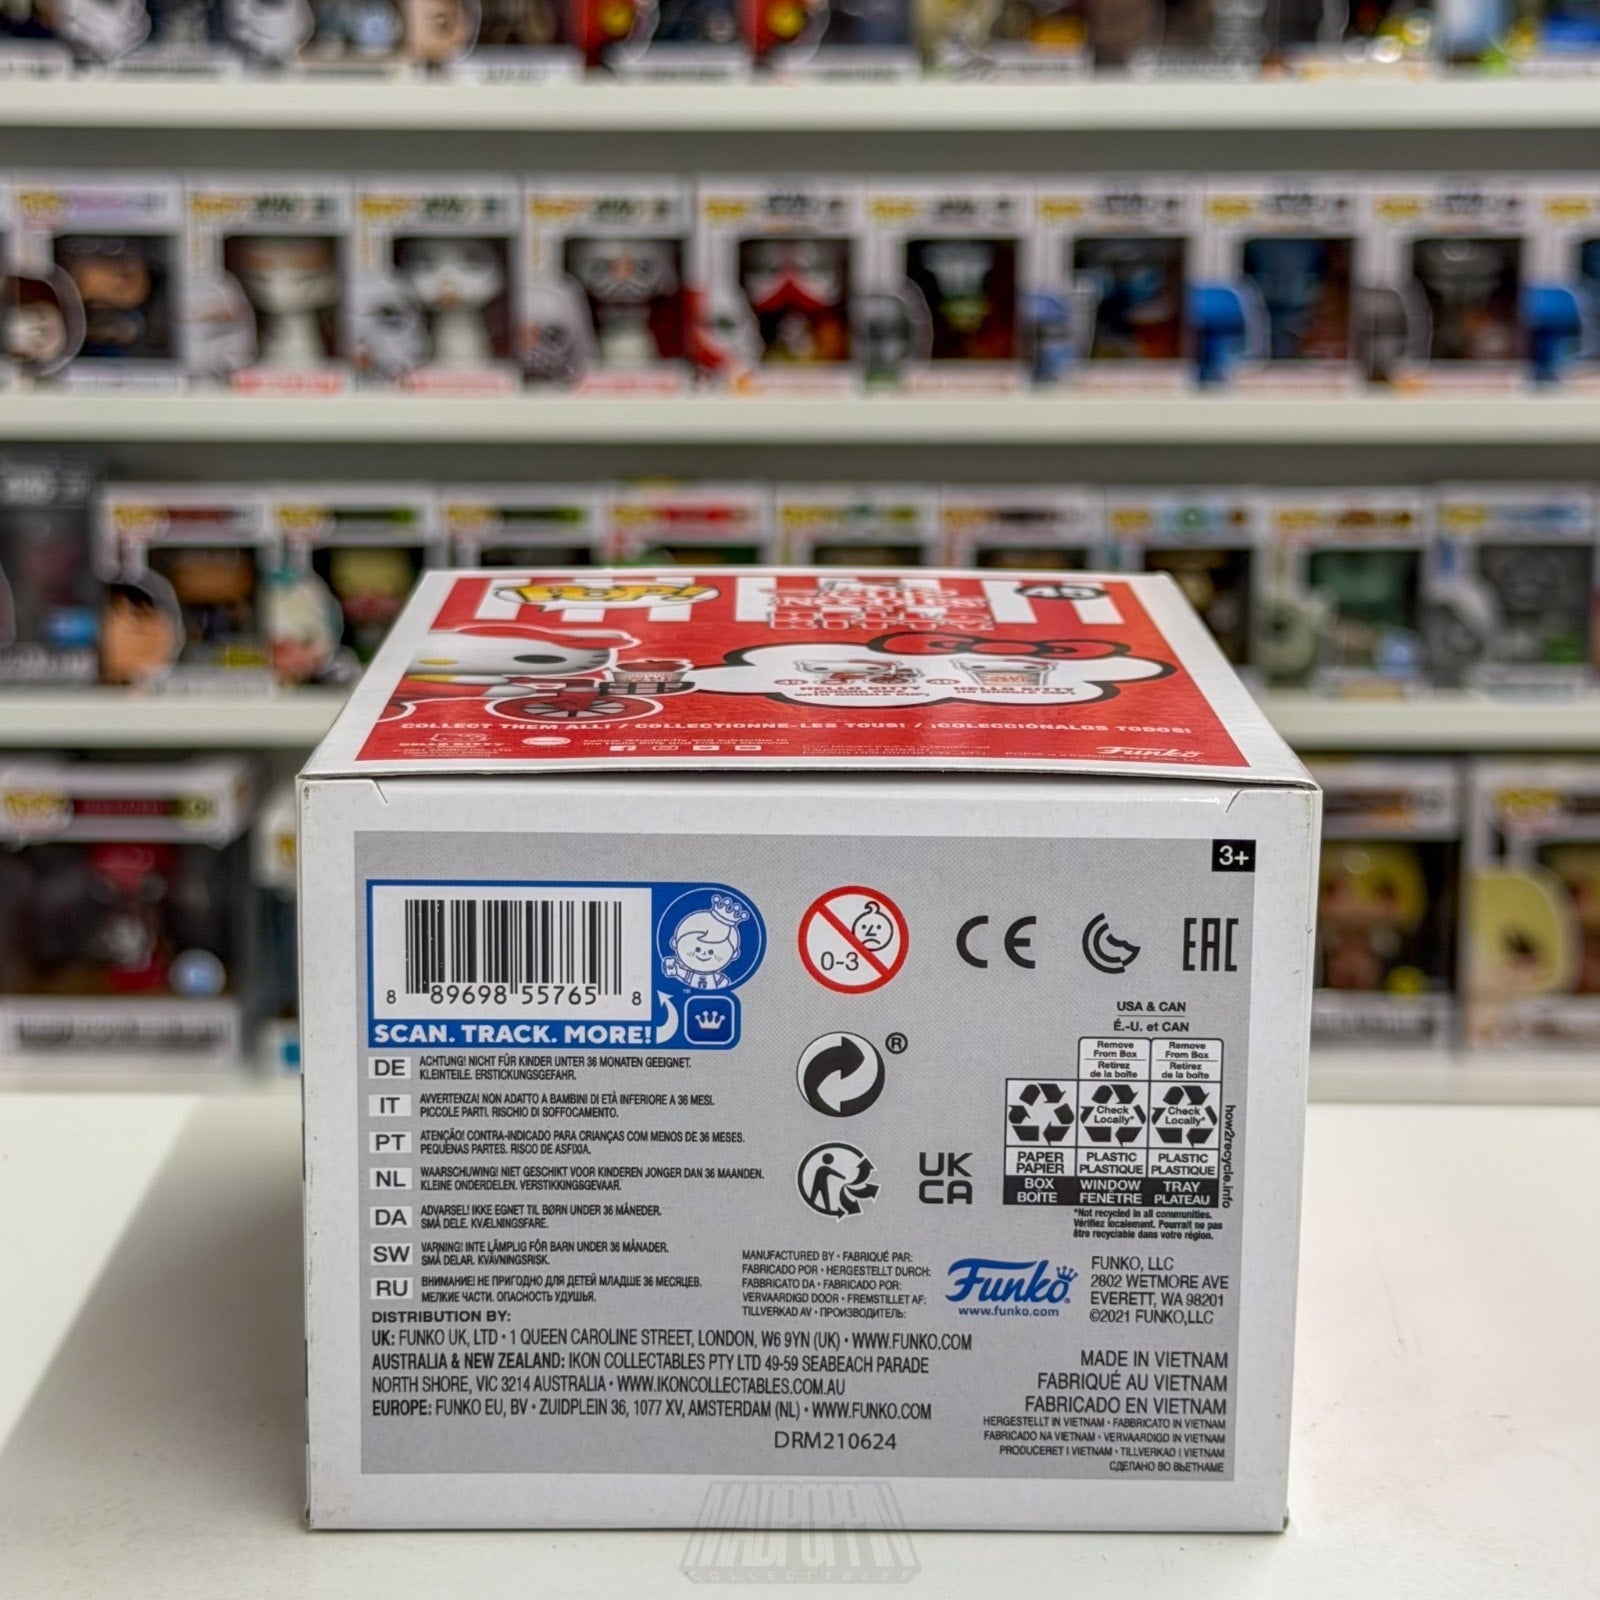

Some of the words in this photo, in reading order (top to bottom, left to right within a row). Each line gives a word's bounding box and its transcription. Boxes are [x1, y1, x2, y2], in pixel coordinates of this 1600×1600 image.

[1115, 725, 1192, 734] TODOS!
[1096, 746, 1204, 758] Funko
[1219, 846, 1250, 866] 3+
[956, 915, 1037, 969] CE
[821, 951, 860, 972] 0-3
[386, 989, 397, 1005] 8
[430, 985, 508, 1005] 89698
[521, 985, 597, 1005] 55765
[631, 991, 643, 1006] 8
[1116, 1001, 1143, 1011] USA
[1146, 1001, 1155, 1011] &
[1158, 1001, 1186, 1012] CAN
[1113, 1018, 1142, 1031] É.-U.
[1146, 1021, 1158, 1031] et
[1161, 1021, 1189, 1032] CAN
[374, 1024, 455, 1042] SCAN.
[461, 1024, 557, 1043] TRACK.
[564, 1025, 651, 1043] MORE!
[374, 1059, 406, 1077] DE
[419, 1055, 466, 1066] ACHTUNG!
[468, 1055, 496, 1066] NICHT
[498, 1054, 516, 1066] FÜR
[518, 1055, 552, 1066] KINDER
[554, 1056, 584, 1067] UNTER
[586, 1056, 597, 1067] 36
[599, 1056, 643, 1067] MONATEN
[645, 1056, 691, 1068] GEEIGNET.
[419, 1069, 472, 1080] KLEINTEILE.
[475, 1069, 576, 1080] ERSTICKUNGSGEFAHR.
[380, 1097, 401, 1114] IT
[376, 1134, 406, 1151] PT
[466, 1129, 551, 1141] CONTRA-INDICADO
[553, 1130, 577, 1141] PARA
[578, 1130, 624, 1143] CRIANÇAS
[626, 1130, 648, 1141] COM
[650, 1130, 682, 1142] MENOS
[684, 1131, 697, 1142] DE
[699, 1131, 709, 1142] 36
[712, 1131, 744, 1142] MESES.
[1017, 1151, 1063, 1164] PAPER
[1086, 1151, 1137, 1162] PLASTIC
[1158, 1153, 1208, 1163] PLASTIC
[919, 1152, 973, 1178] UK
[1016, 1163, 1064, 1174] PAPIER
[1079, 1164, 1143, 1174] PLASTIQUE
[1150, 1165, 1215, 1175] PLASTIQUE
[376, 1170, 406, 1187] NL
[1024, 1177, 1054, 1190] BOX
[1080, 1179, 1141, 1190] WINDOW
[919, 1179, 974, 1205] CA
[1162, 1181, 1200, 1192] TRAY
[1154, 1194, 1210, 1205] PLATEAU
[375, 1209, 408, 1226] DA
[373, 1246, 410, 1263] SW
[1091, 1255, 1143, 1270] FUNKO,
[1148, 1256, 1173, 1270] LLC
[421, 1275, 475, 1286] ВНИМАНИЕ!
[477, 1275, 489, 1286] НЕ
[492, 1275, 543, 1288] ПРИГОДНО
[544, 1275, 564, 1287] ДЛЯ
[566, 1275, 596, 1288] ДЕТЕЙ
[599, 1275, 641, 1288] МЛАДШЕ
[643, 1275, 653, 1286] 36
[655, 1275, 701, 1288] МЕСЯЦЕВ.
[945, 1257, 1077, 1304] Funko
[1090, 1274, 1122, 1287] 2802
[1125, 1274, 1198, 1288] WETMORE
[1201, 1275, 1228, 1289] AVE
[376, 1280, 408, 1297] RU
[1090, 1291, 1156, 1305] EVERETT,
[1160, 1292, 1183, 1306] WA
[1186, 1293, 1223, 1306] 98201
[372, 1310, 481, 1322] DISTRIBUTION
[486, 1310, 510, 1321] BY:
[958, 1305, 1059, 1316] www.funko.com
[1089, 1308, 1129, 1323] ©2021
[371, 1329, 394, 1346] UK:
[399, 1329, 444, 1345] FUNKO
[448, 1329, 469, 1347] UK,
[473, 1329, 498, 1345] LTD
[510, 1330, 515, 1344] 1
[520, 1330, 567, 1345] QUEEN
[570, 1330, 637, 1345] CAROLINE
[641, 1330, 694, 1346] STREET,
[698, 1330, 757, 1347] LONDON,
[761, 1331, 781, 1347] W6
[784, 1331, 810, 1347] 9YN
[813, 1331, 840, 1349] (UK)
[851, 1332, 972, 1350] WWW.FUNKO.COM
[372, 1352, 447, 1370] AUSTRALIA
[451, 1353, 460, 1369] &
[464, 1353, 494, 1369] NEW
[497, 1353, 564, 1369] ZEALAND:
[568, 1353, 600, 1368] IKON
[604, 1353, 705, 1369] COLLECTABLES
[708, 1354, 734, 1370] PTY
[737, 1354, 761, 1370] LTD
[764, 1355, 798, 1371] 49-59
[802, 1355, 872, 1372] SEABEACH
[876, 1356, 928, 1373] PARADE
[1080, 1349, 1128, 1366] MADE
[1133, 1350, 1148, 1367] IN
[1154, 1351, 1228, 1368] VIETNAM
[372, 1376, 418, 1393] NORTH
[421, 1375, 472, 1393] SHORE,
[475, 1376, 497, 1391] VIC
[501, 1376, 530, 1392] 3214
[533, 1376, 606, 1391] AUSTRALIA
[617, 1376, 845, 1394] WWW.IKONCOLLECTABLES.COM.AU
[1037, 1370, 1121, 1390] FABRIQUÉ
[1125, 1373, 1148, 1391] AU
[1153, 1374, 1227, 1391] VIETNAM
[372, 1398, 431, 1416] EUROPE:
[435, 1398, 481, 1415] FUNKO
[485, 1399, 506, 1417] EU,
[510, 1399, 528, 1415] BV
[539, 1399, 607, 1415] ZUIDPLEIN
[611, 1399, 629, 1417] 36,
[634, 1400, 662, 1415] 1077
[665, 1400, 685, 1418] XV,
[687, 1400, 771, 1417] AMSTERDAM
[775, 1401, 800, 1420] (NL)
[812, 1401, 931, 1419] WWW.FUNKO.COM
[1025, 1395, 1120, 1413] FABRICADO
[1125, 1397, 1147, 1413] EN
[1153, 1397, 1226, 1414] VIETNAM
[774, 1430, 896, 1450] DRM210624
